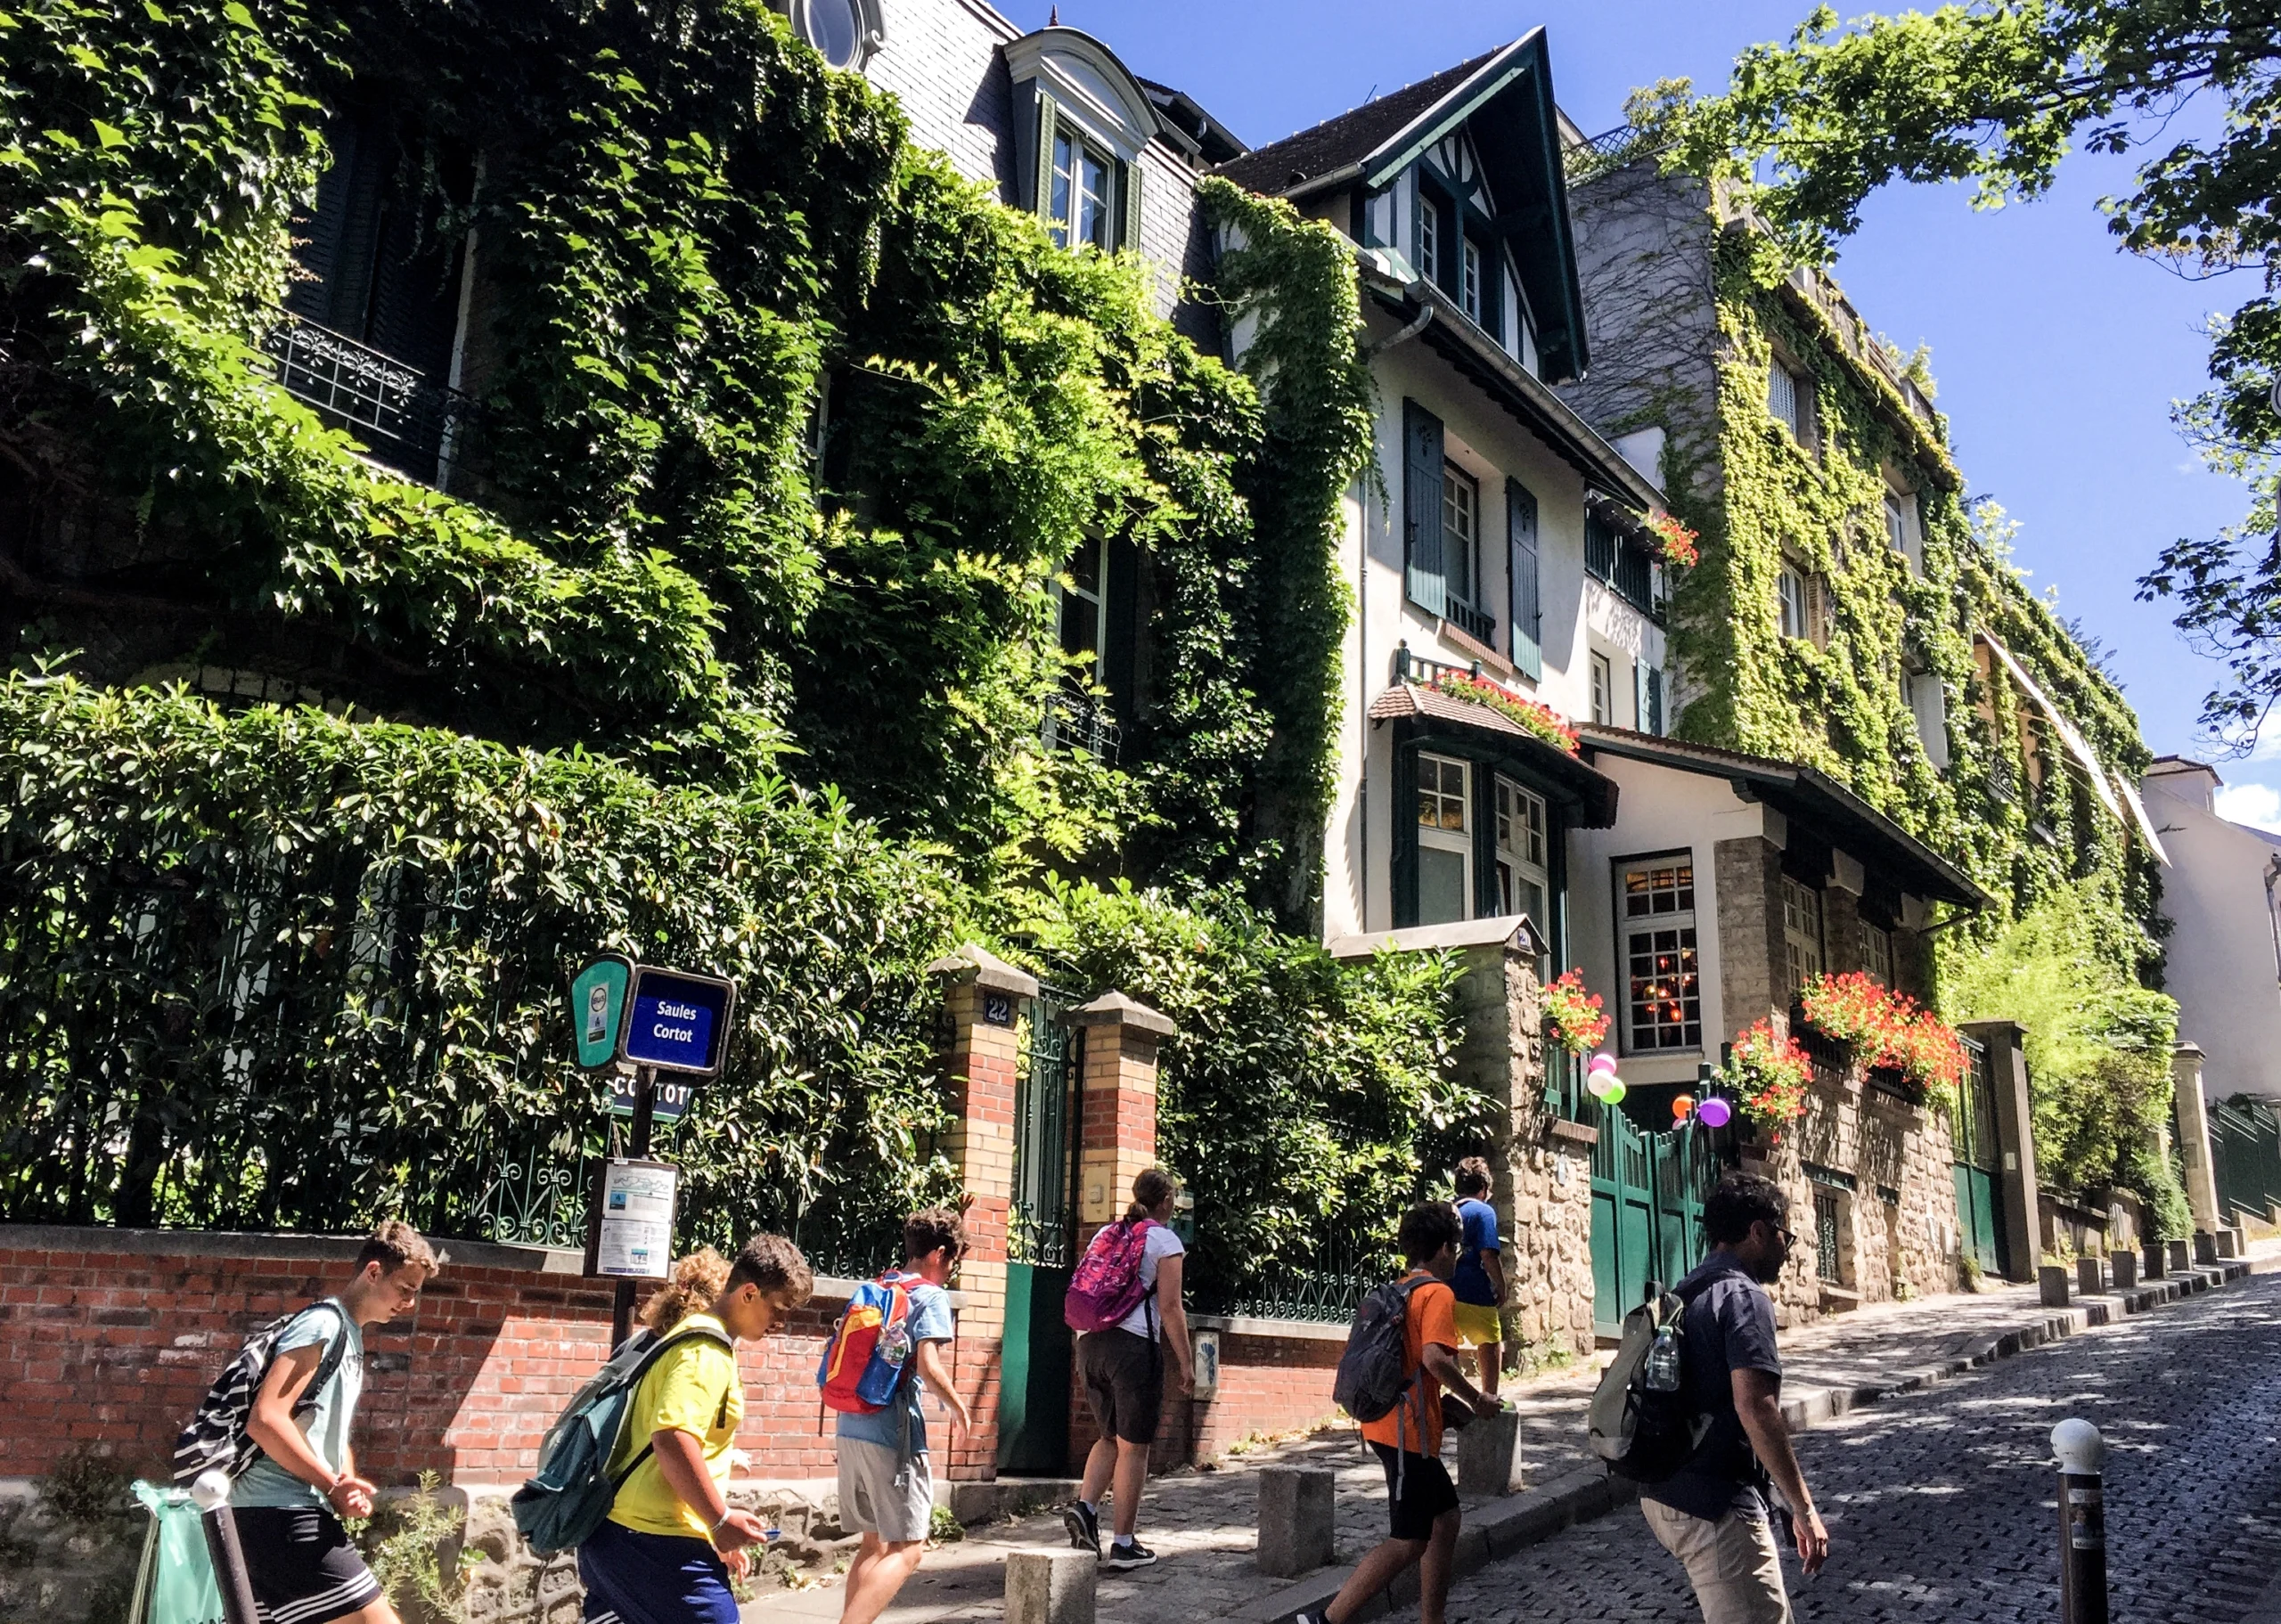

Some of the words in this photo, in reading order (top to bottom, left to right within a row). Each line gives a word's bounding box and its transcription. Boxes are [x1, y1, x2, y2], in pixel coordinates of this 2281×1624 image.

[657, 1000, 697, 1021] Saules
[988, 998, 1008, 1022] 22
[653, 1023, 693, 1043] Cortot
[614, 1076, 687, 1106] COTOT
